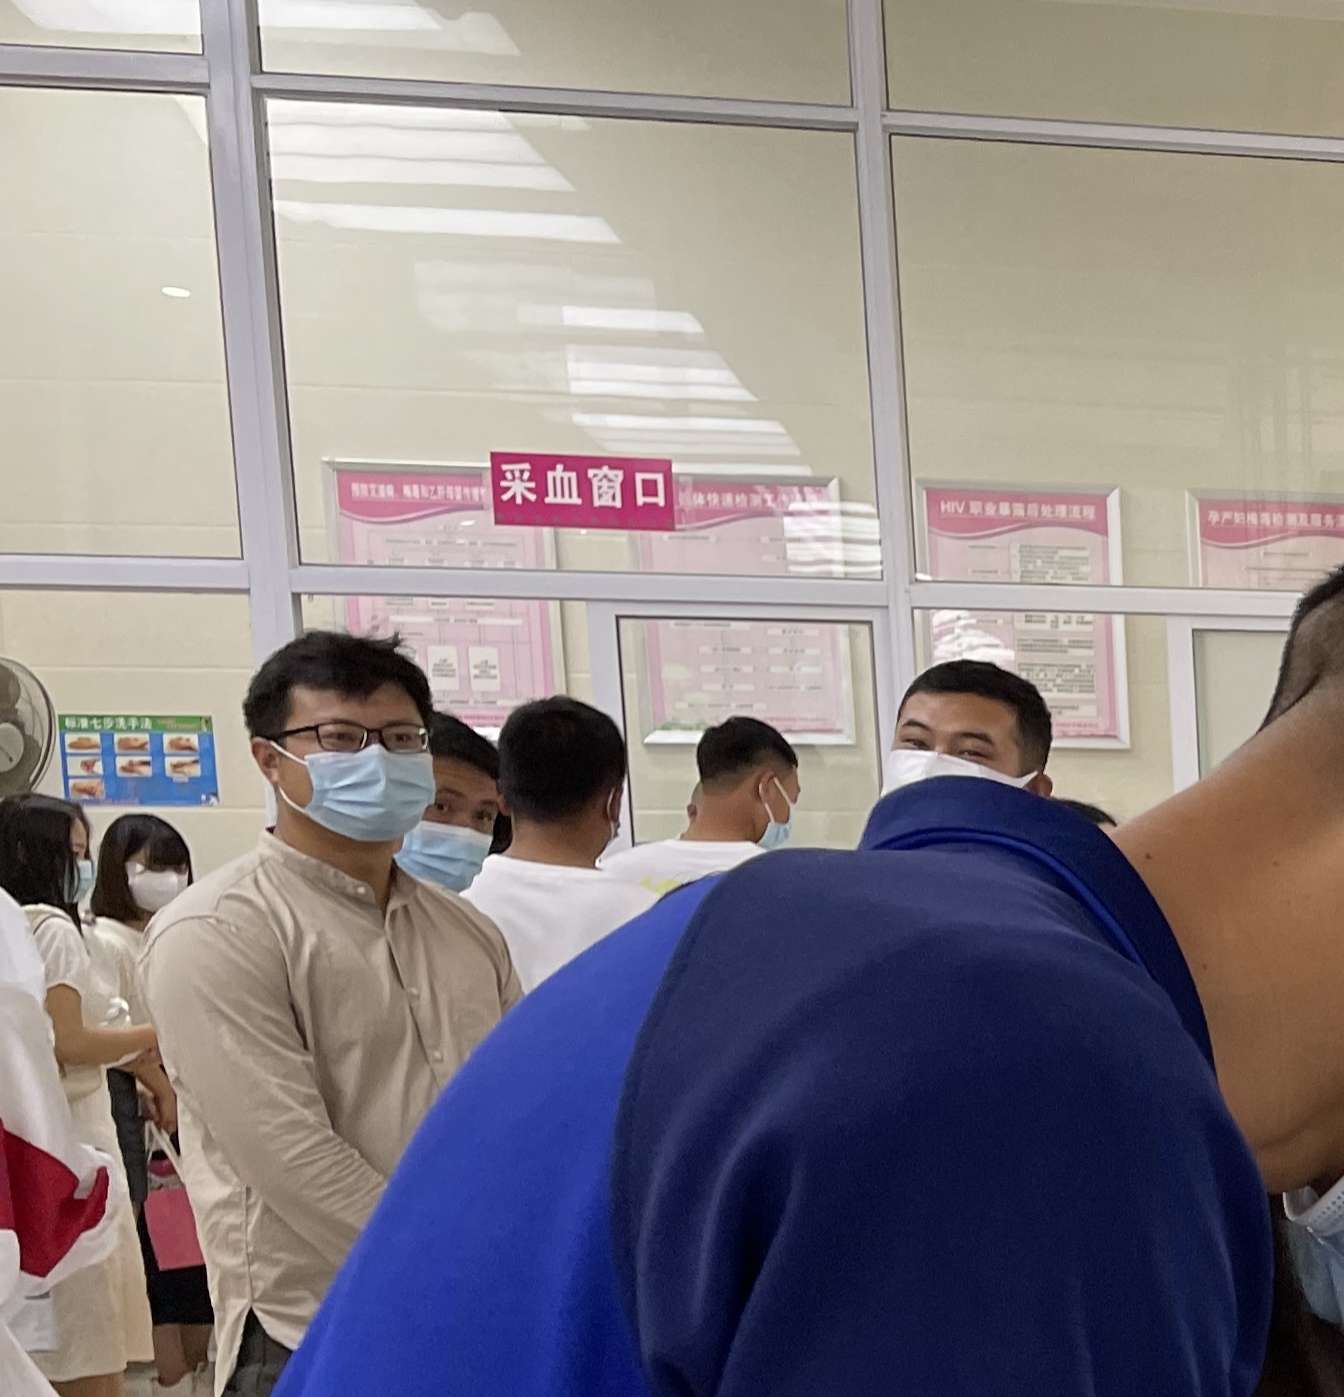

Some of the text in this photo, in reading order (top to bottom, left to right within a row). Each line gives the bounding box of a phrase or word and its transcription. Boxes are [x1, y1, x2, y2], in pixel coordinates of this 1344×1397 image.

[499, 462, 667, 510] 采血窗口
[940, 499, 966, 515] HIV
[65, 716, 152, 730] 标准七步洗手法
